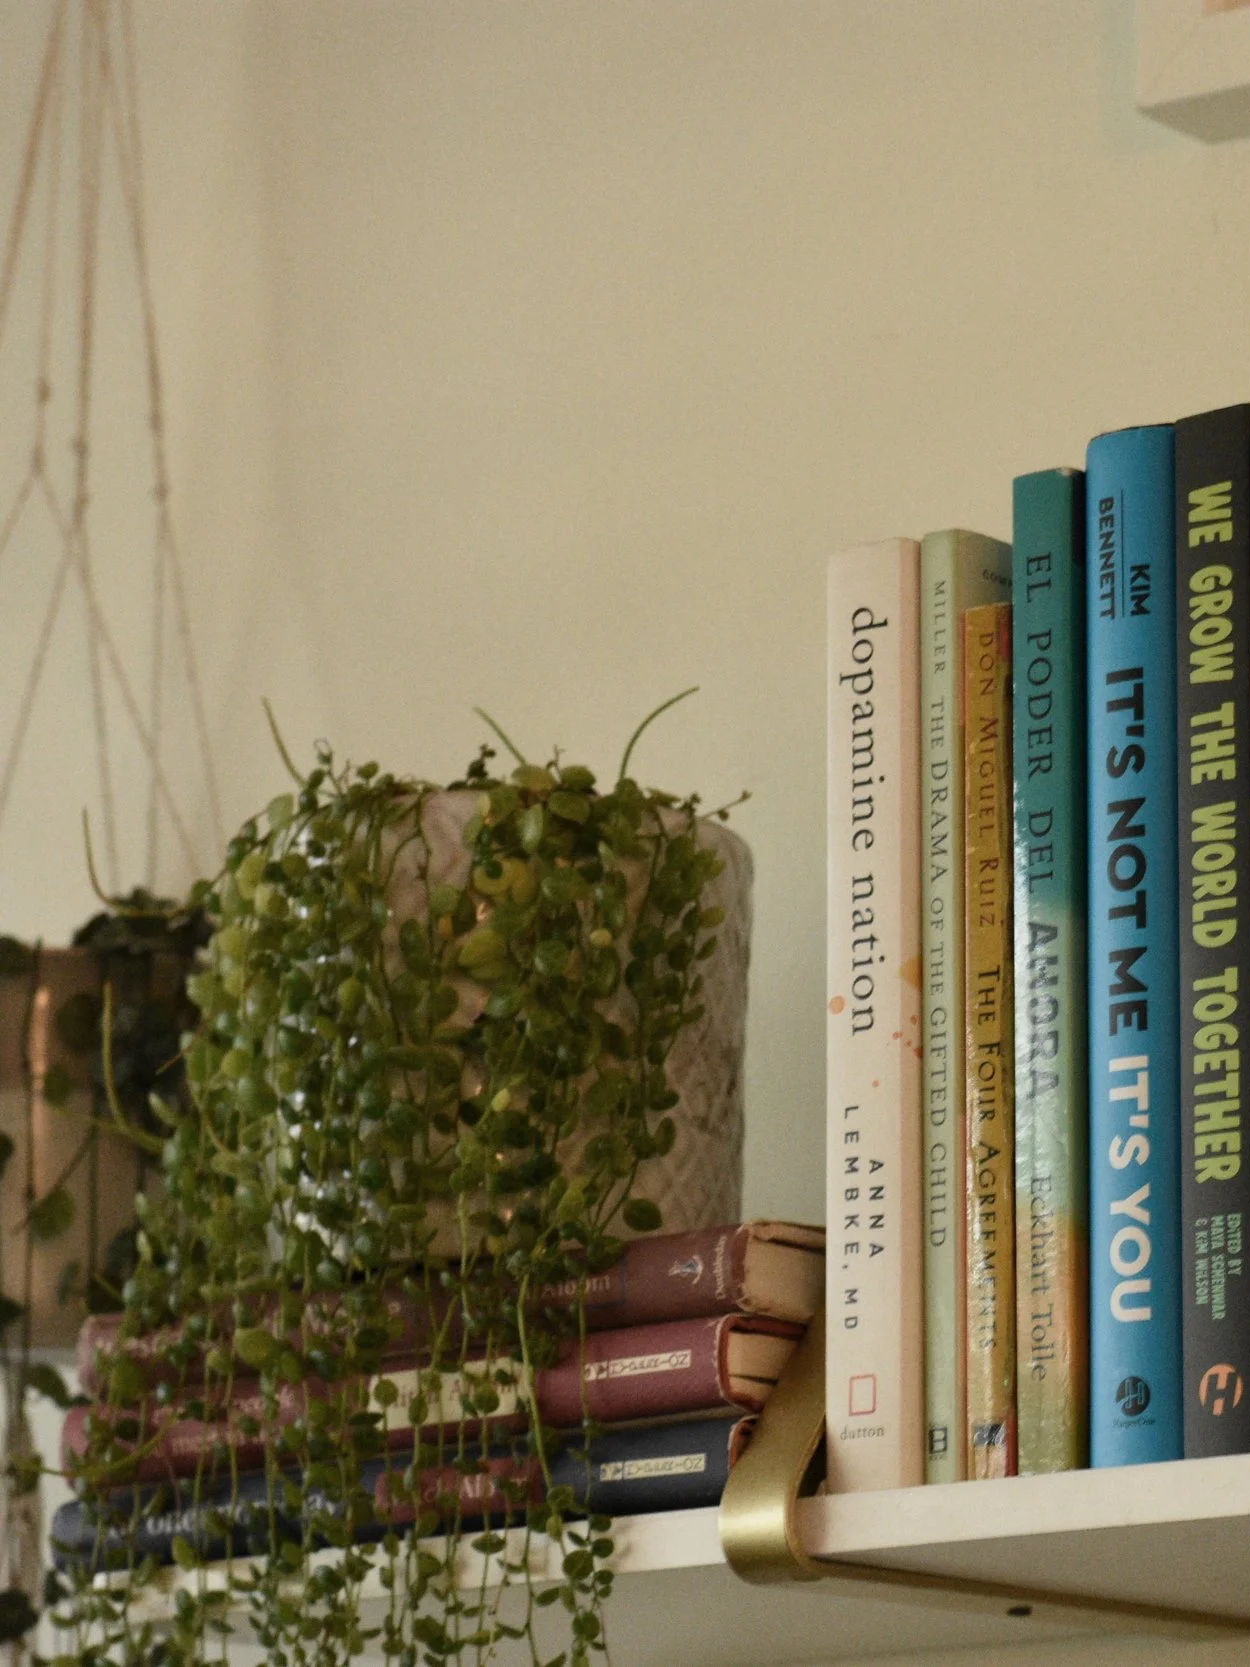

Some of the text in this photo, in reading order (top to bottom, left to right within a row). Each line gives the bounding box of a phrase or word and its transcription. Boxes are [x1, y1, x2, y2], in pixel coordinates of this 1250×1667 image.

[1027, 552, 1051, 604] EL
[1100, 497, 1116, 620] BENNETT
[1130, 564, 1150, 617] KIM
[978, 633, 995, 695] DON
[1027, 629, 1053, 782] PODER
[840, 607, 888, 1037] dopamine nation
[978, 715, 1000, 838] MIGUEL
[1188, 480, 1242, 1184] WE GROW THE WORLD TOGETHER
[1028, 807, 1054, 893] DEL
[930, 580, 949, 1248] MILLER THE DRAMA OF THE GIFTED CHILD
[977, 965, 1000, 1025] THE
[1106, 667, 1152, 1323] IT'S NOT ME IT'S YOU
[976, 1043, 1001, 1122] FOUR
[842, 1105, 861, 1330] LEMBKE, MD
[868, 1159, 885, 1258] ANNA
[1030, 1175, 1056, 1382] Eckhart Tolle
[840, 1426, 885, 1441] dutton
